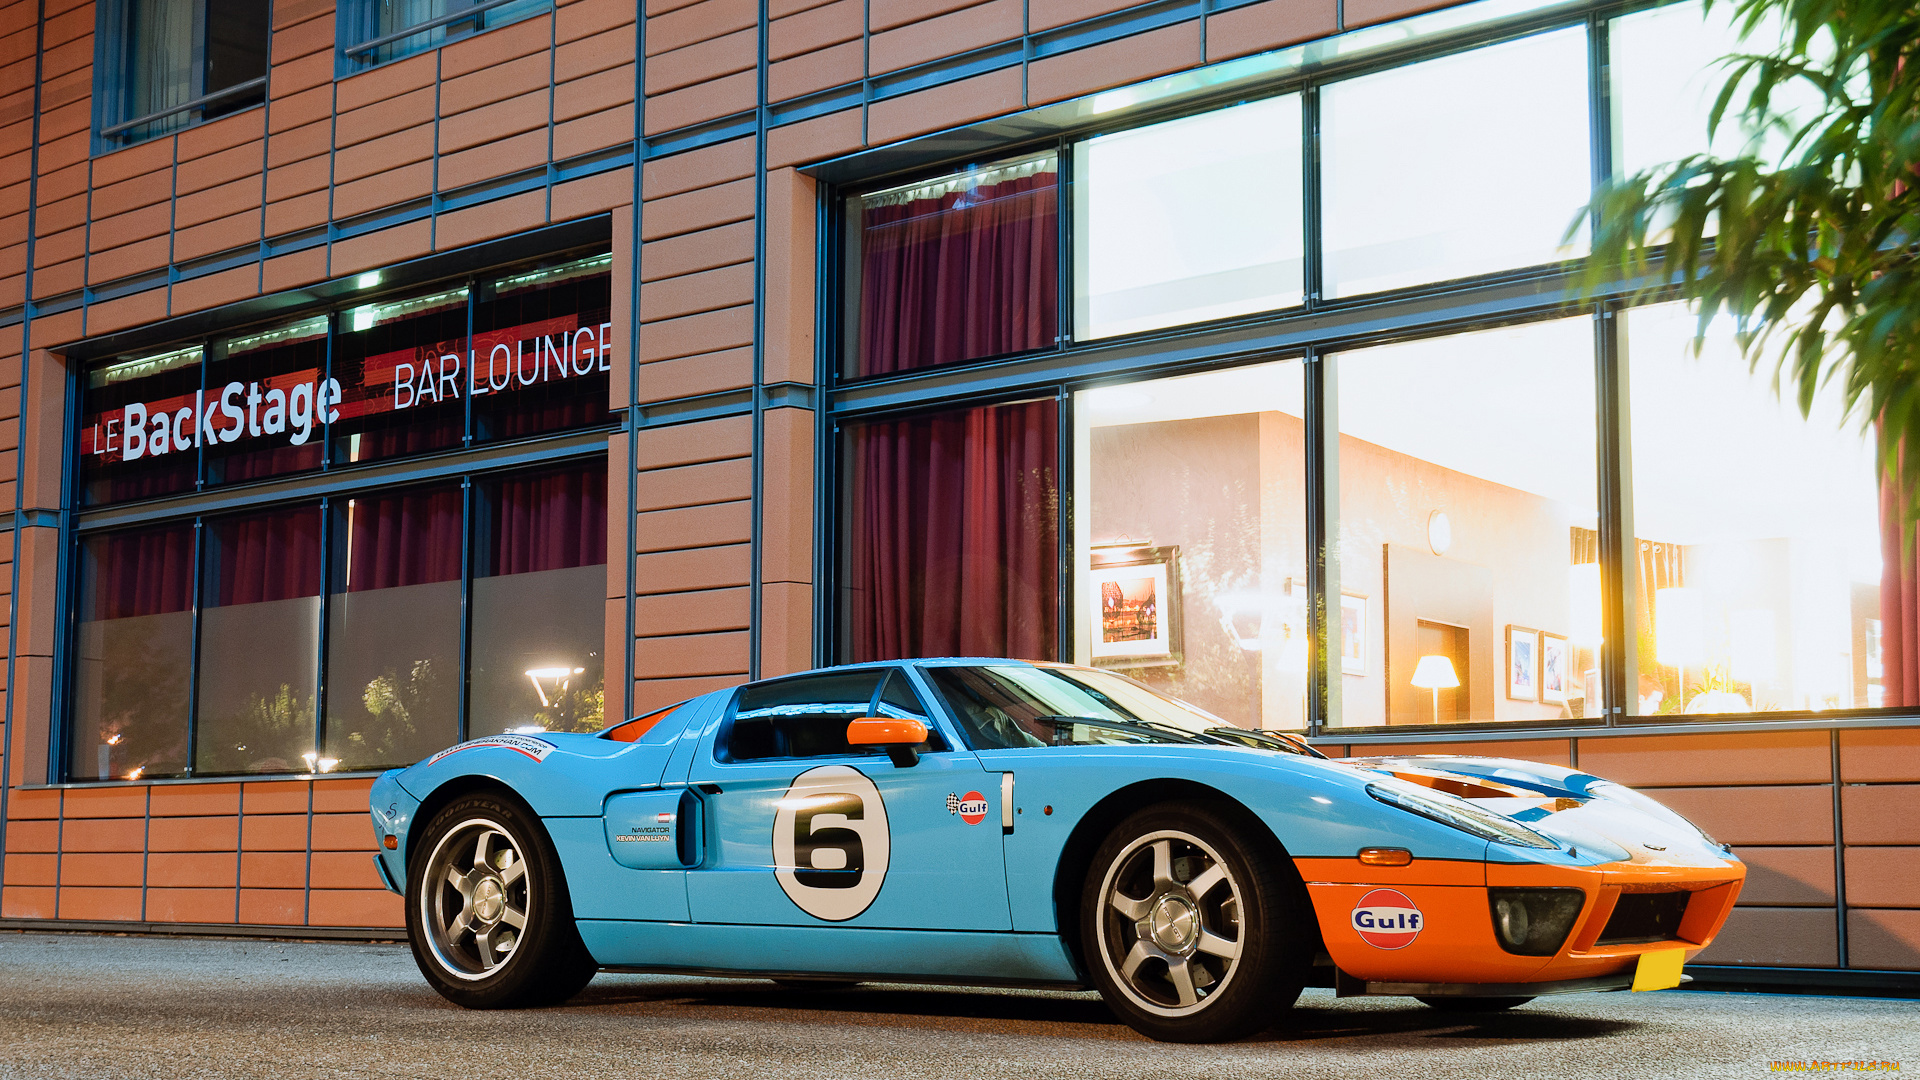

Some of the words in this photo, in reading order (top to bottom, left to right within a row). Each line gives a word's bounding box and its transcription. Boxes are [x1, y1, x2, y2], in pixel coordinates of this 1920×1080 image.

[93, 419, 119, 455] LE
[122, 377, 341, 461] BackStage
[394, 354, 460, 410] BAR
[470, 322, 611, 395] LOUNGE
[959, 803, 987, 812] Gulf
[794, 792, 864, 889] 6
[1355, 911, 1420, 929] Gulf
